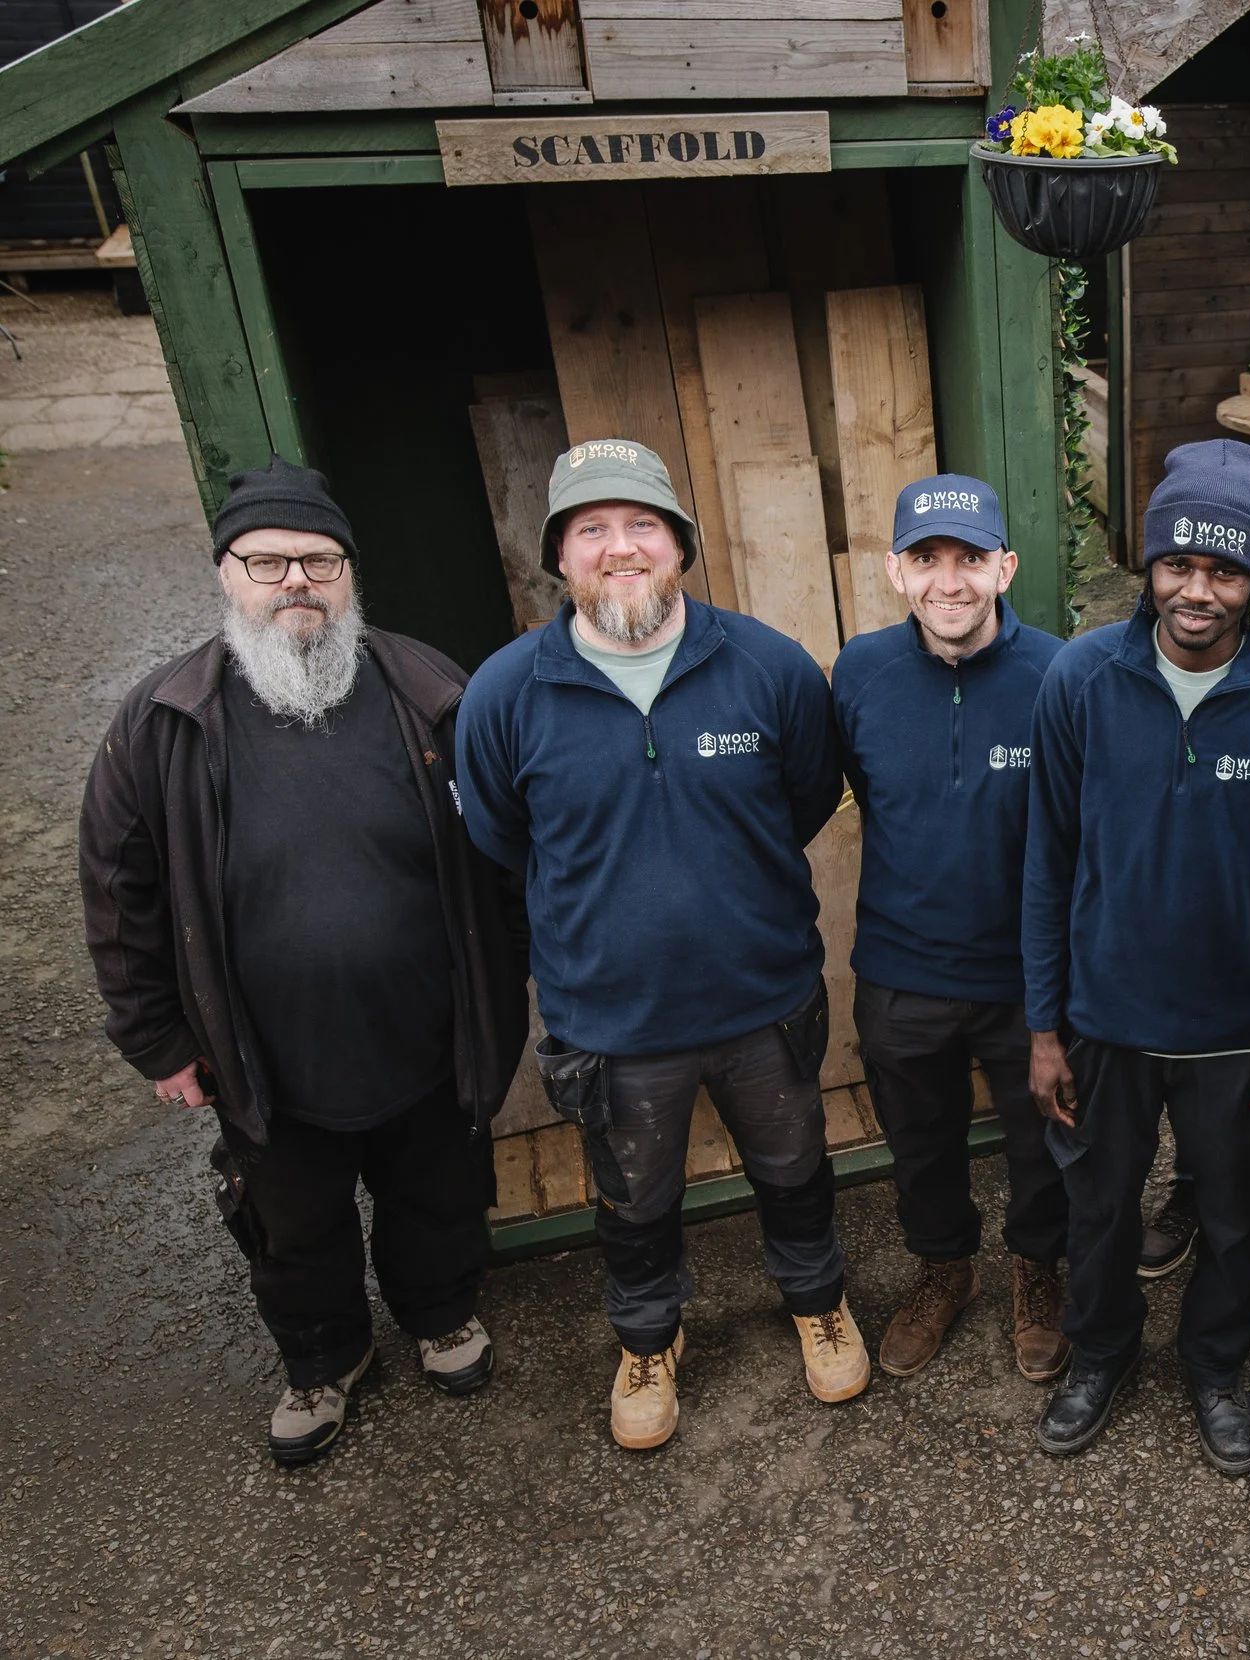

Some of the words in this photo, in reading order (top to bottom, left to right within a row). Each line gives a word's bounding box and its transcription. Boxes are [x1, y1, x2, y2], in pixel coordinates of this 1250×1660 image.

[512, 130, 766, 168] SCAFFOLD
[588, 443, 638, 458] WOOD
[588, 451, 637, 466] SHACK
[933, 491, 979, 504] WOOD
[933, 500, 979, 514] SHACK
[1197, 521, 1247, 543] WOOD
[1195, 533, 1245, 555] SHACK
[718, 732, 760, 745] WOOD
[718, 742, 759, 755] SHACK
[1009, 747, 1031, 758] WO
